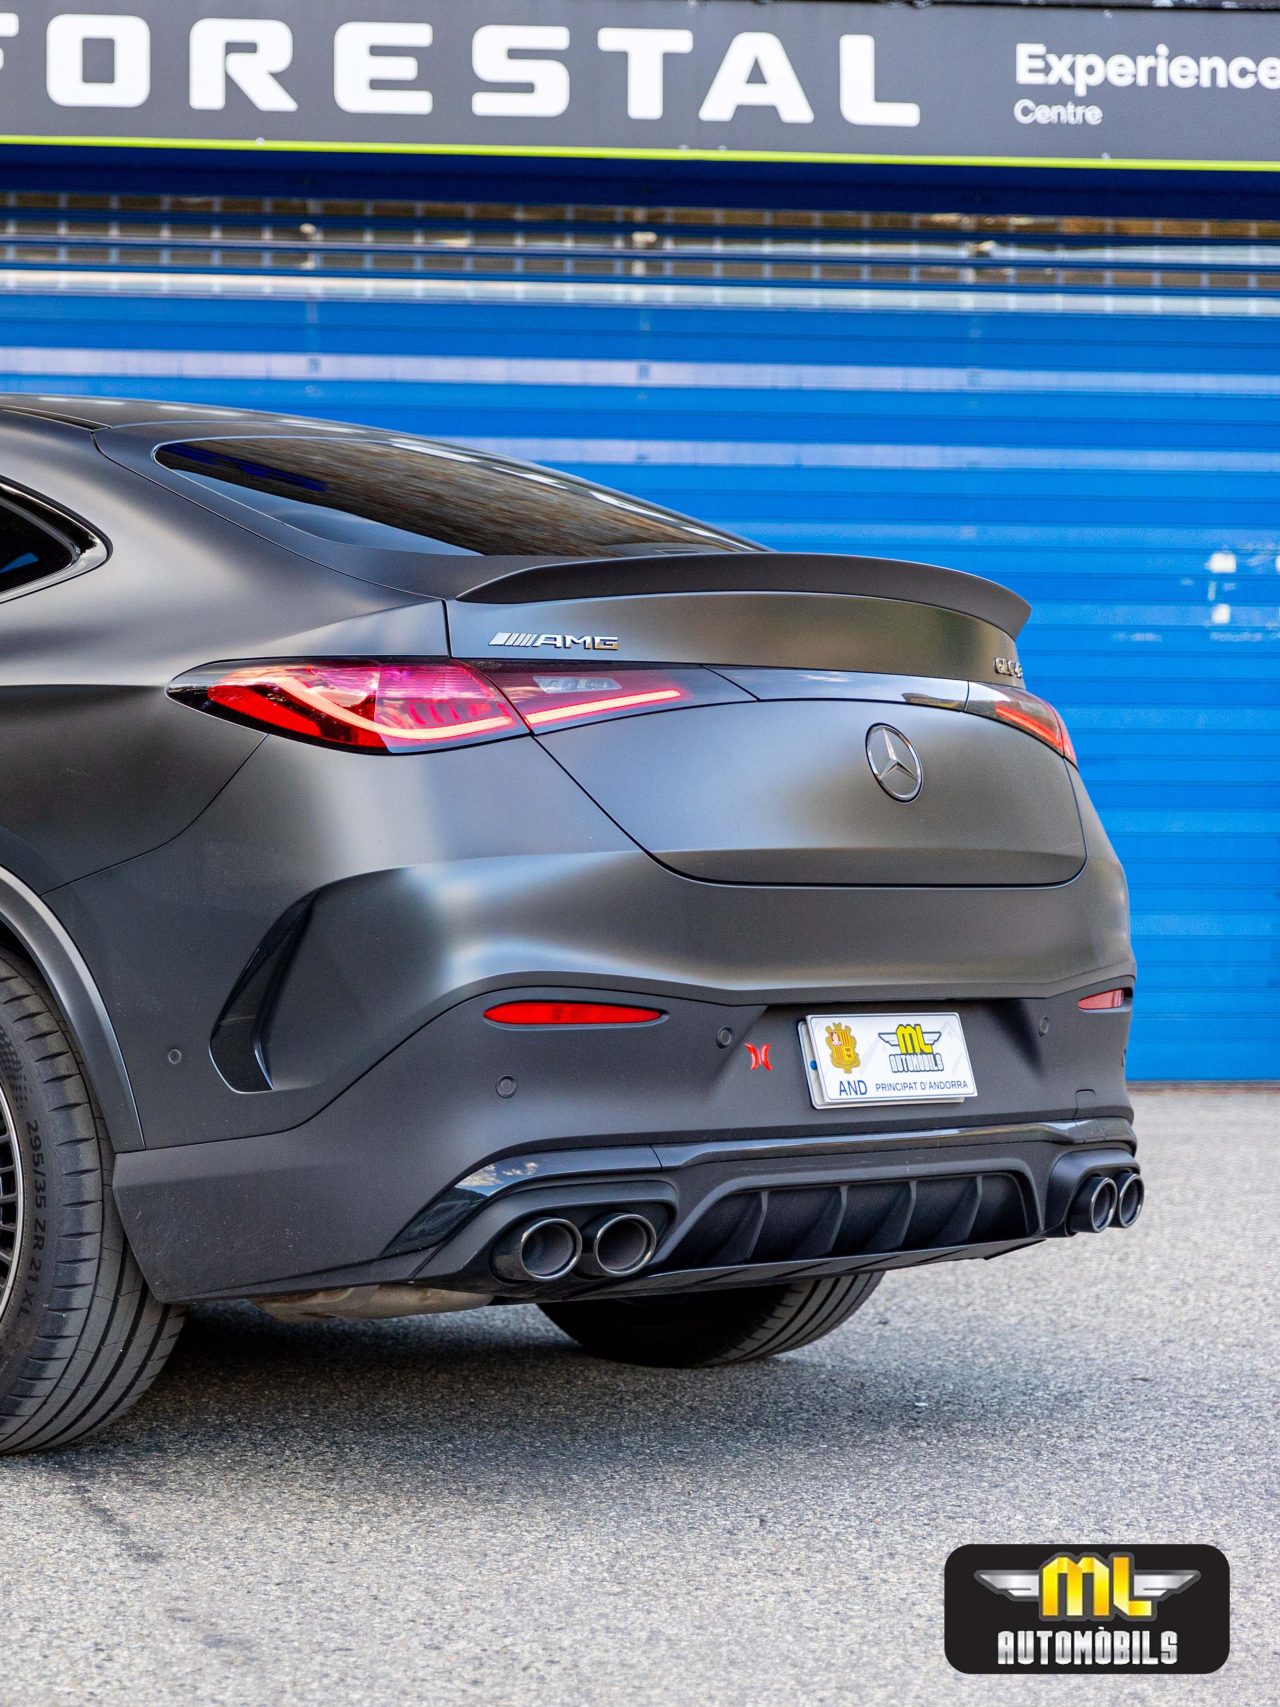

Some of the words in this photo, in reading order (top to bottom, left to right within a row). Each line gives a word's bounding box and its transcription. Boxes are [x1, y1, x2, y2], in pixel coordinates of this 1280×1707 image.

[1016, 43, 1280, 97] Experience
[1014, 98, 1103, 125] Centre
[531, 633, 619, 650] AMG
[896, 1024, 934, 1055] ML
[838, 1079, 868, 1097] AND
[875, 1081, 918, 1092] PRINCIPAT
[920, 1079, 969, 1091] D'ANDORRA
[26, 1119, 47, 1209] 295/35
[32, 1217, 47, 1251] ZR
[27, 1257, 42, 1283] 21
